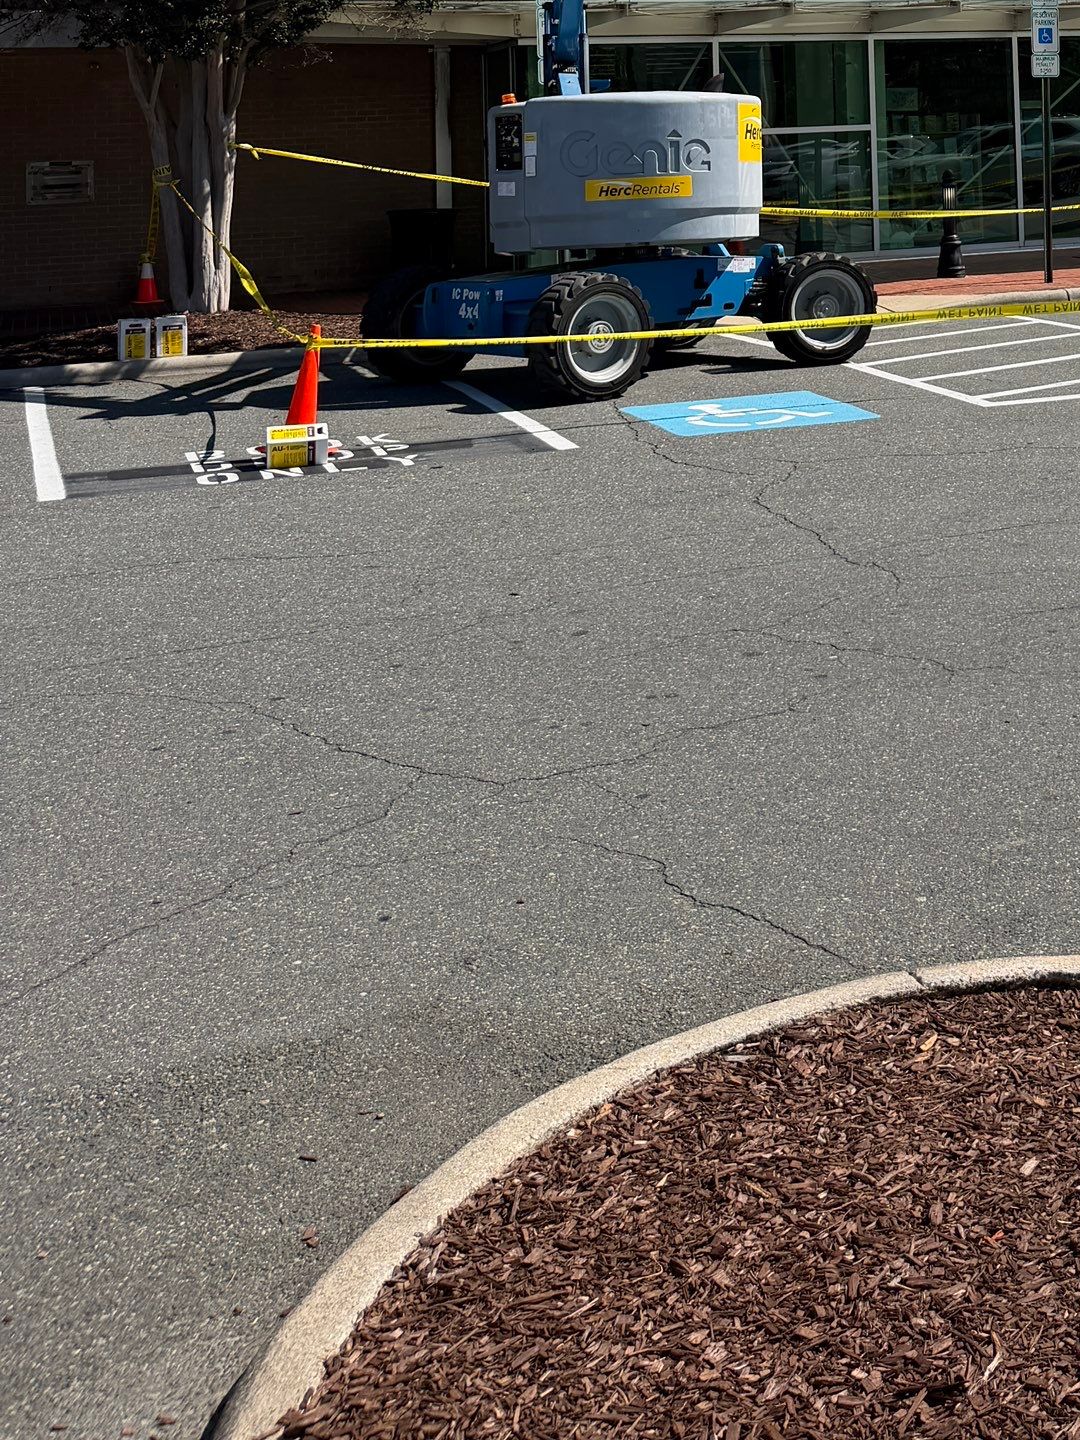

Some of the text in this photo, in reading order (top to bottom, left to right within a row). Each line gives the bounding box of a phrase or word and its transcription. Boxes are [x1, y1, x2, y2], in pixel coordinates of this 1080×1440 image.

[560, 128, 712, 178] Genie
[598, 181, 681, 197] HercRentals
[451, 288, 462, 300] IC
[458, 302, 480, 319] 4x4
[189, 443, 410, 473] DOP
[195, 454, 418, 485] ONLY
